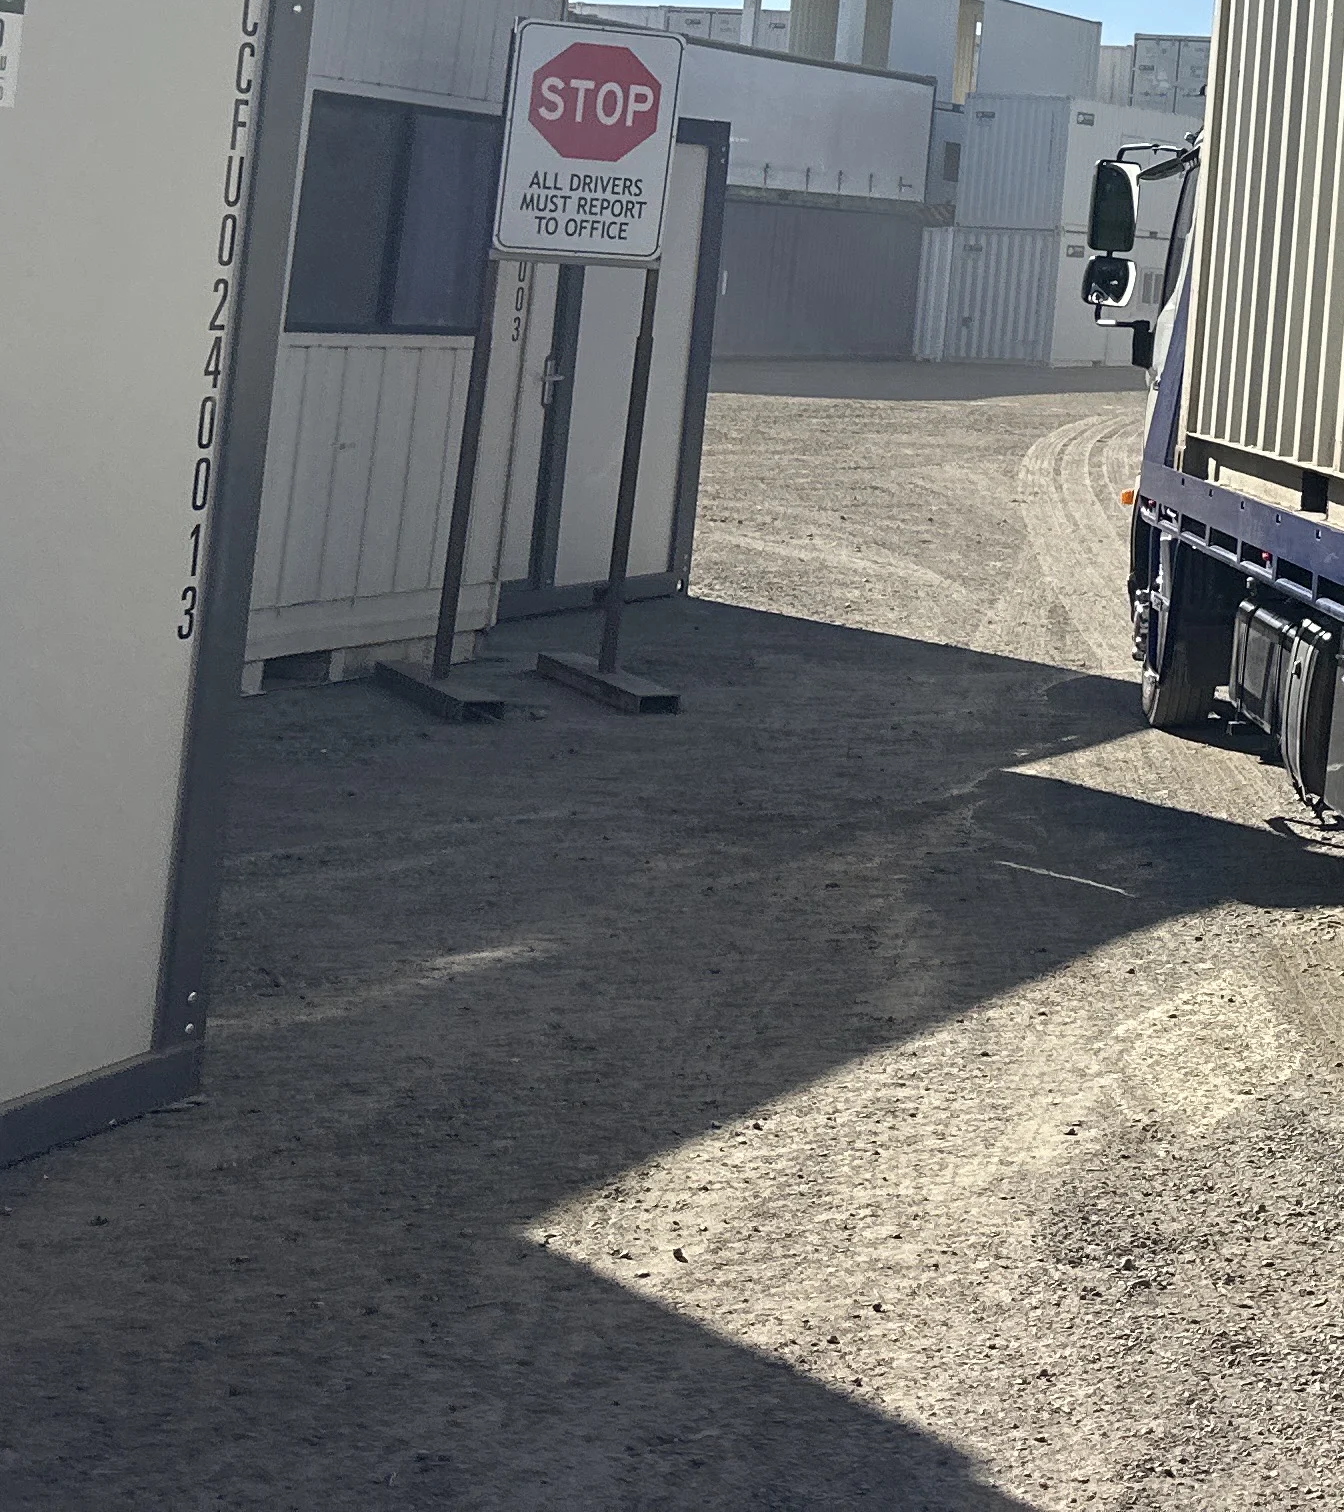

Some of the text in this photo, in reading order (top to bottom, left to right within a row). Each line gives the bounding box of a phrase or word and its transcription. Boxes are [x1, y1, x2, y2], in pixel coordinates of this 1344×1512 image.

[537, 76, 655, 128] STOP
[529, 170, 643, 197] ALL DRIVERS
[519, 192, 647, 220] MUST REPORT
[534, 215, 629, 241] TO OFFICE
